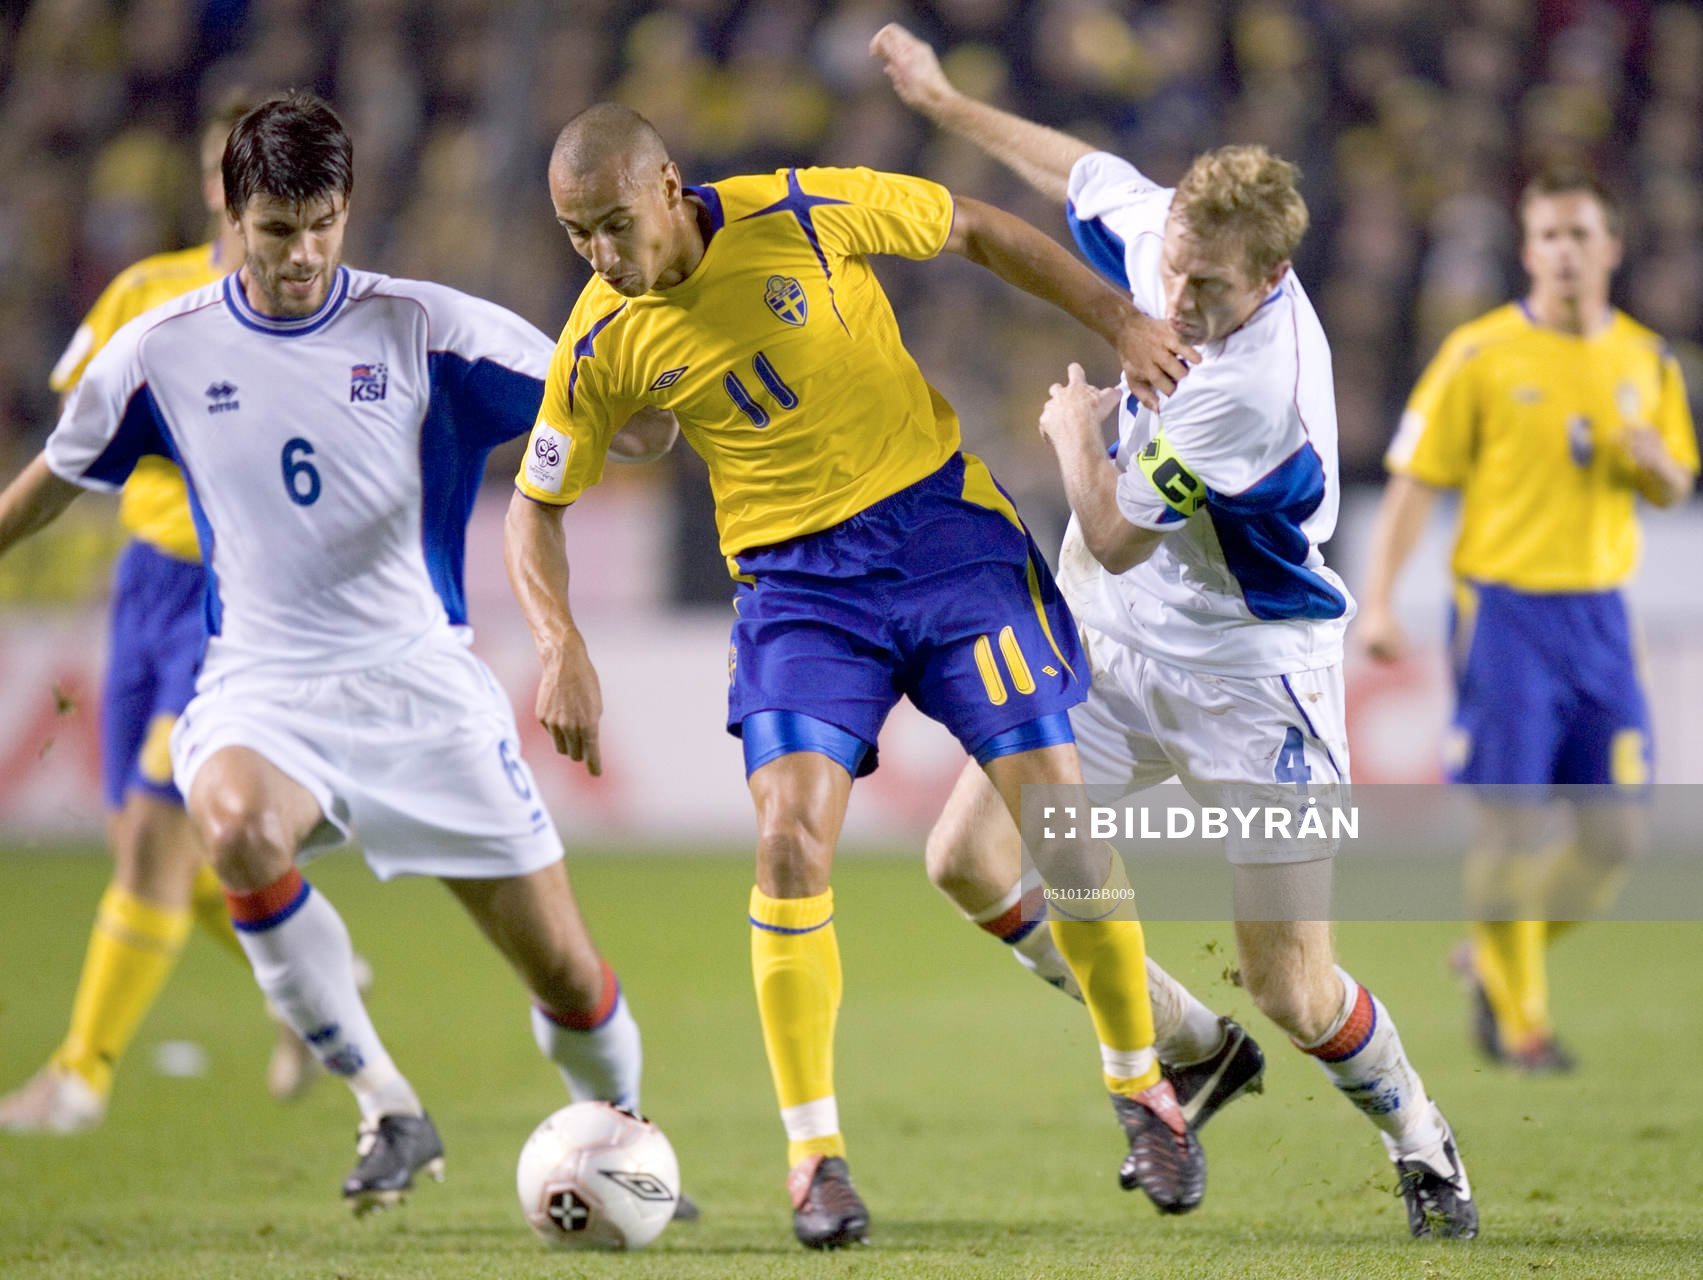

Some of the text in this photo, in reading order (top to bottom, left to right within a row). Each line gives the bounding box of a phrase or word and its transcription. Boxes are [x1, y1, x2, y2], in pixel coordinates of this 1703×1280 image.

[723, 351, 799, 428] 11
[281, 437, 321, 507] 6
[1152, 457, 1198, 503] C
[974, 625, 1036, 706] 11
[499, 740, 531, 800] 6
[1274, 726, 1312, 795] 4
